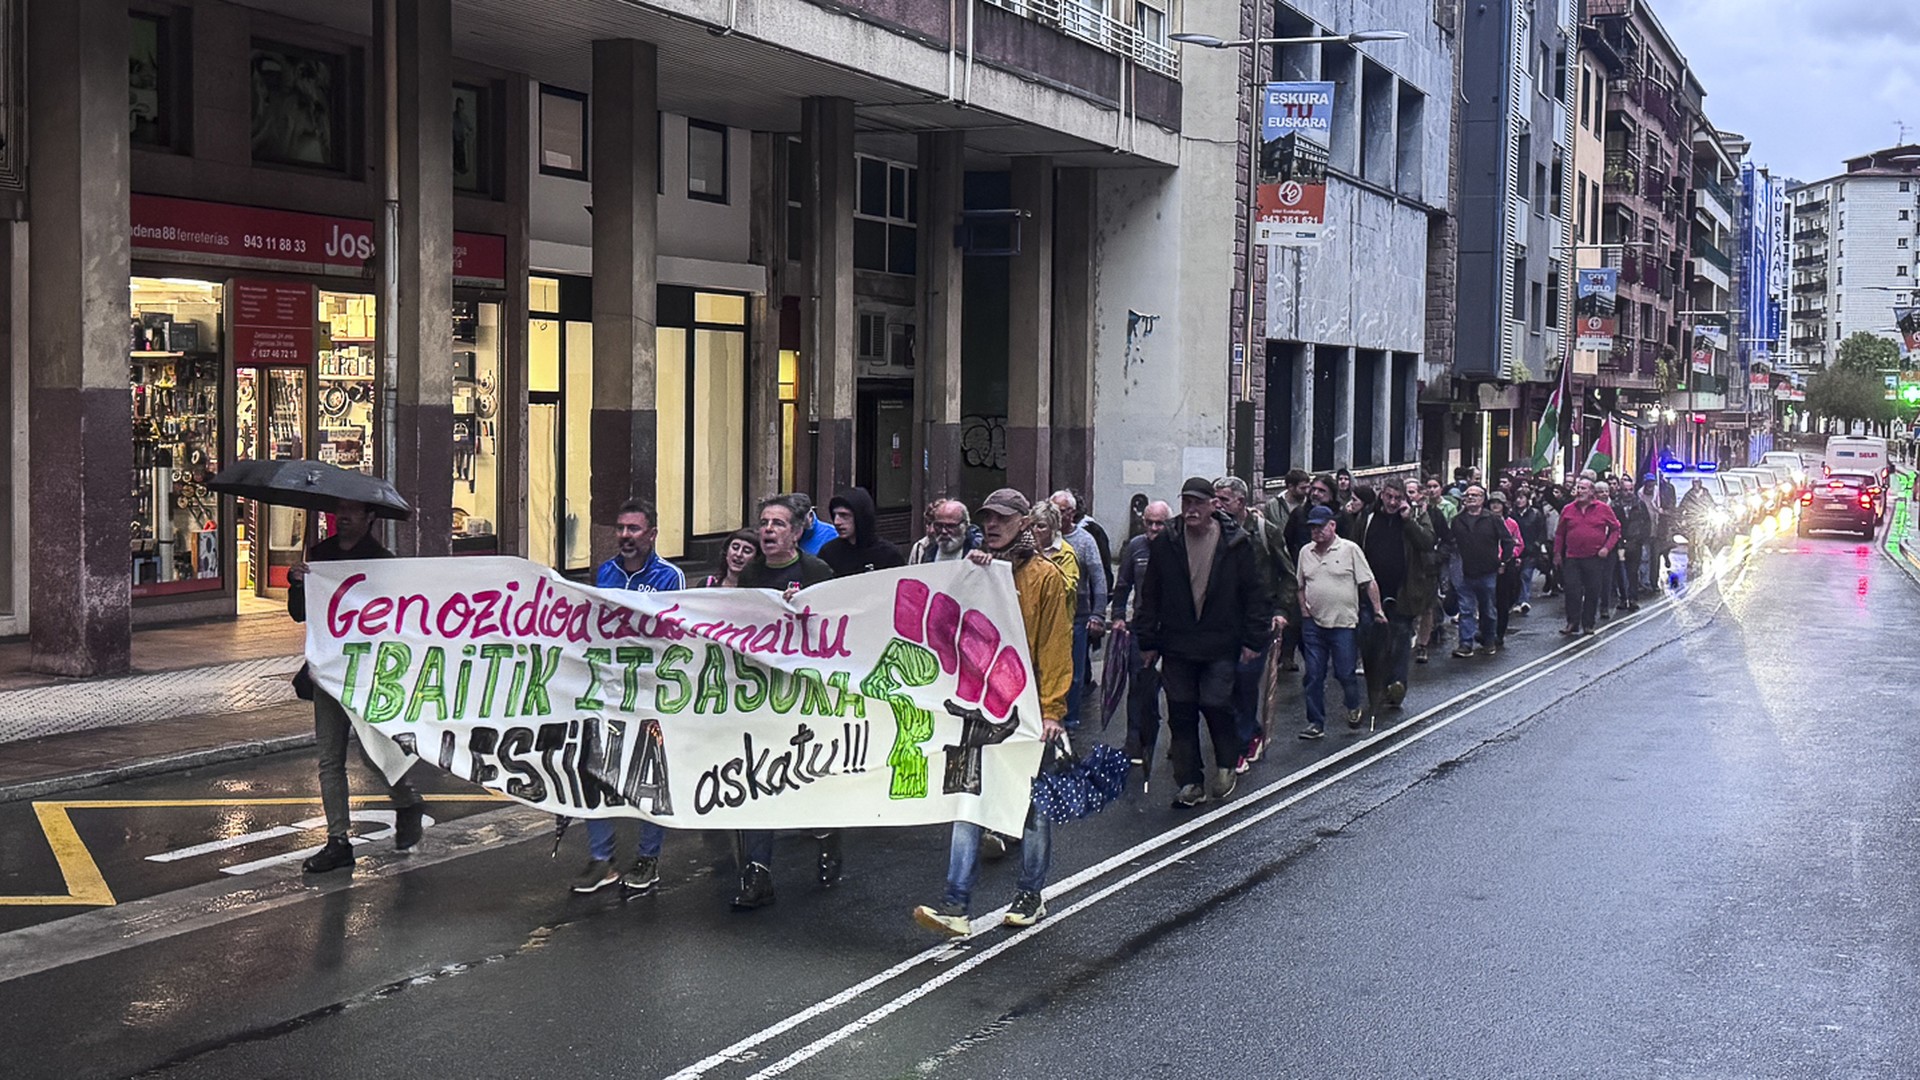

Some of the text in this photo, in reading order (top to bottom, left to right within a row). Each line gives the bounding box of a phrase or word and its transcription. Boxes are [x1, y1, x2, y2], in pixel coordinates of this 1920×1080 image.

[1269, 92, 1329, 105] ESKURA
[1283, 104, 1313, 118] TU
[1268, 117, 1327, 128] EUSKARA
[243, 234, 306, 253] 943 11 88 33
[1773, 186, 1783, 286] KURSAAL
[327, 573, 592, 643] Genozidioa
